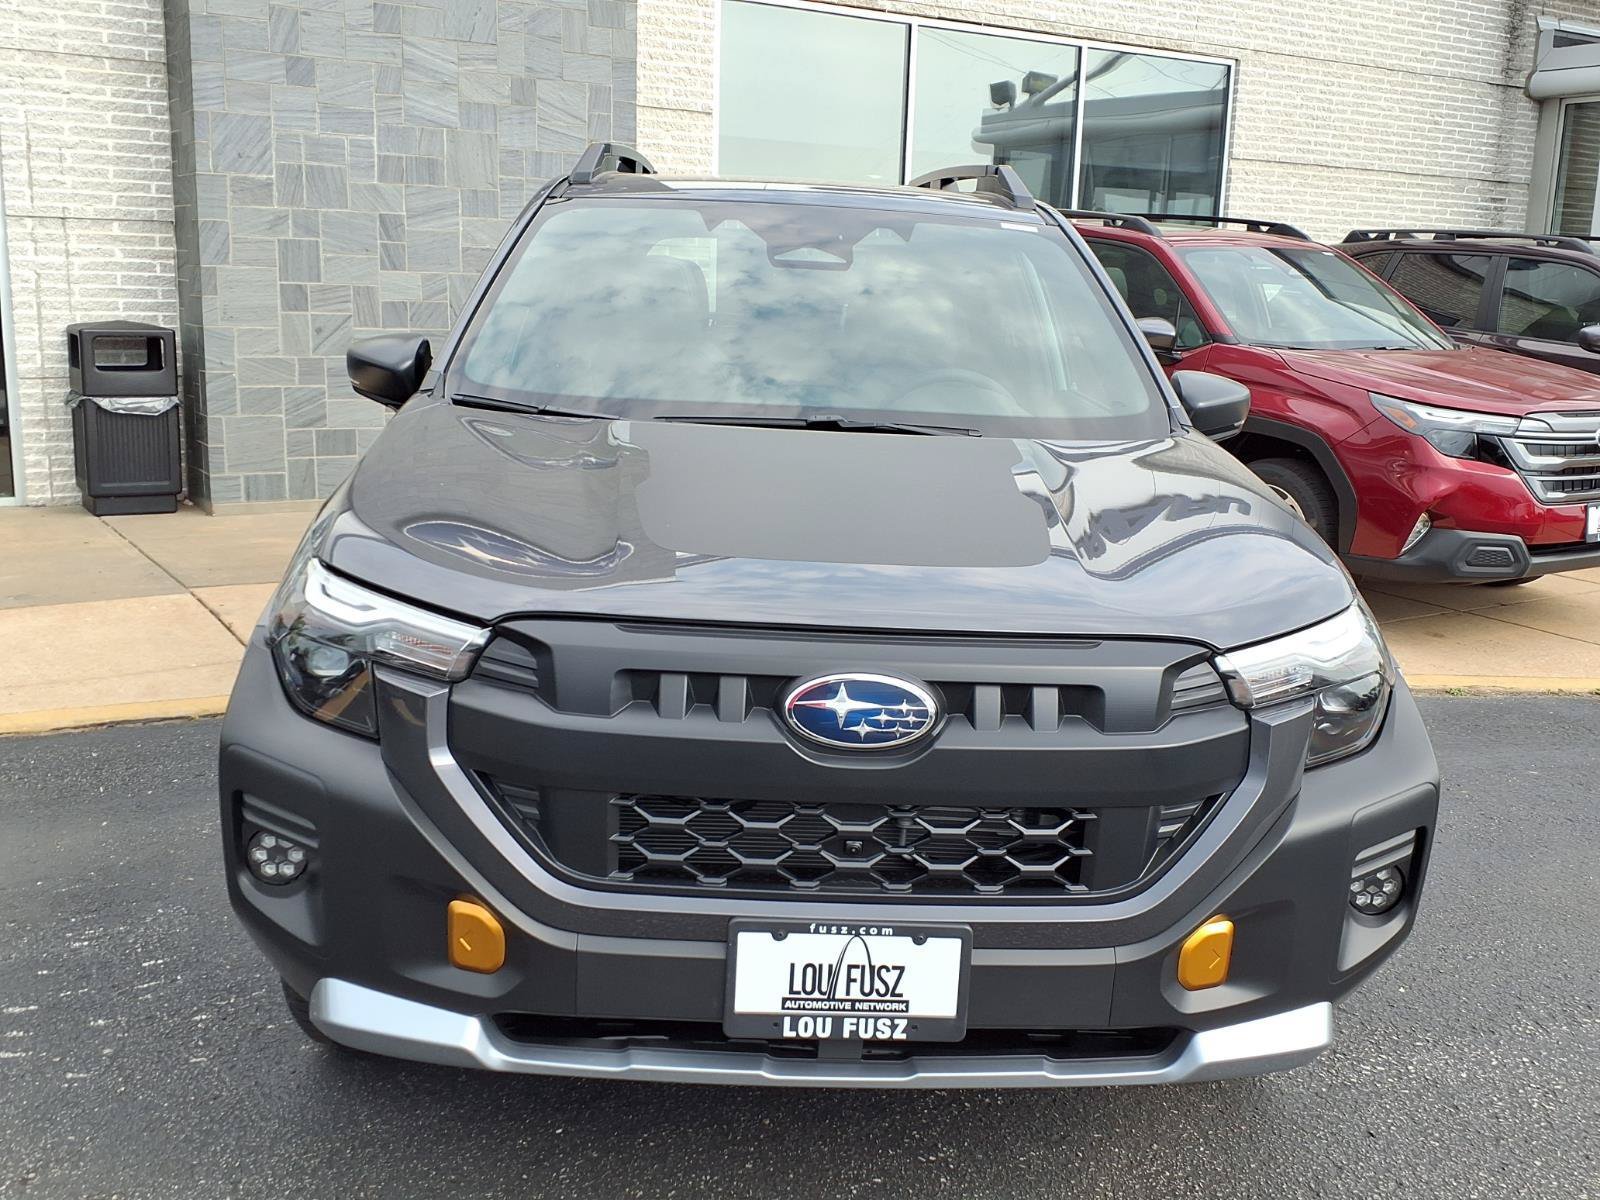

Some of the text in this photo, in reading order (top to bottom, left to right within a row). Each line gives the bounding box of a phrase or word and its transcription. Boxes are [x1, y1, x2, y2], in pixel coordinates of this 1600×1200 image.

[810, 923, 893, 936] fusz.com
[788, 962, 906, 998] LOU FUSZ
[784, 1000, 907, 1012] AUTOMOTIVE NETWORK
[783, 1016, 908, 1040] LOU FUSZ
